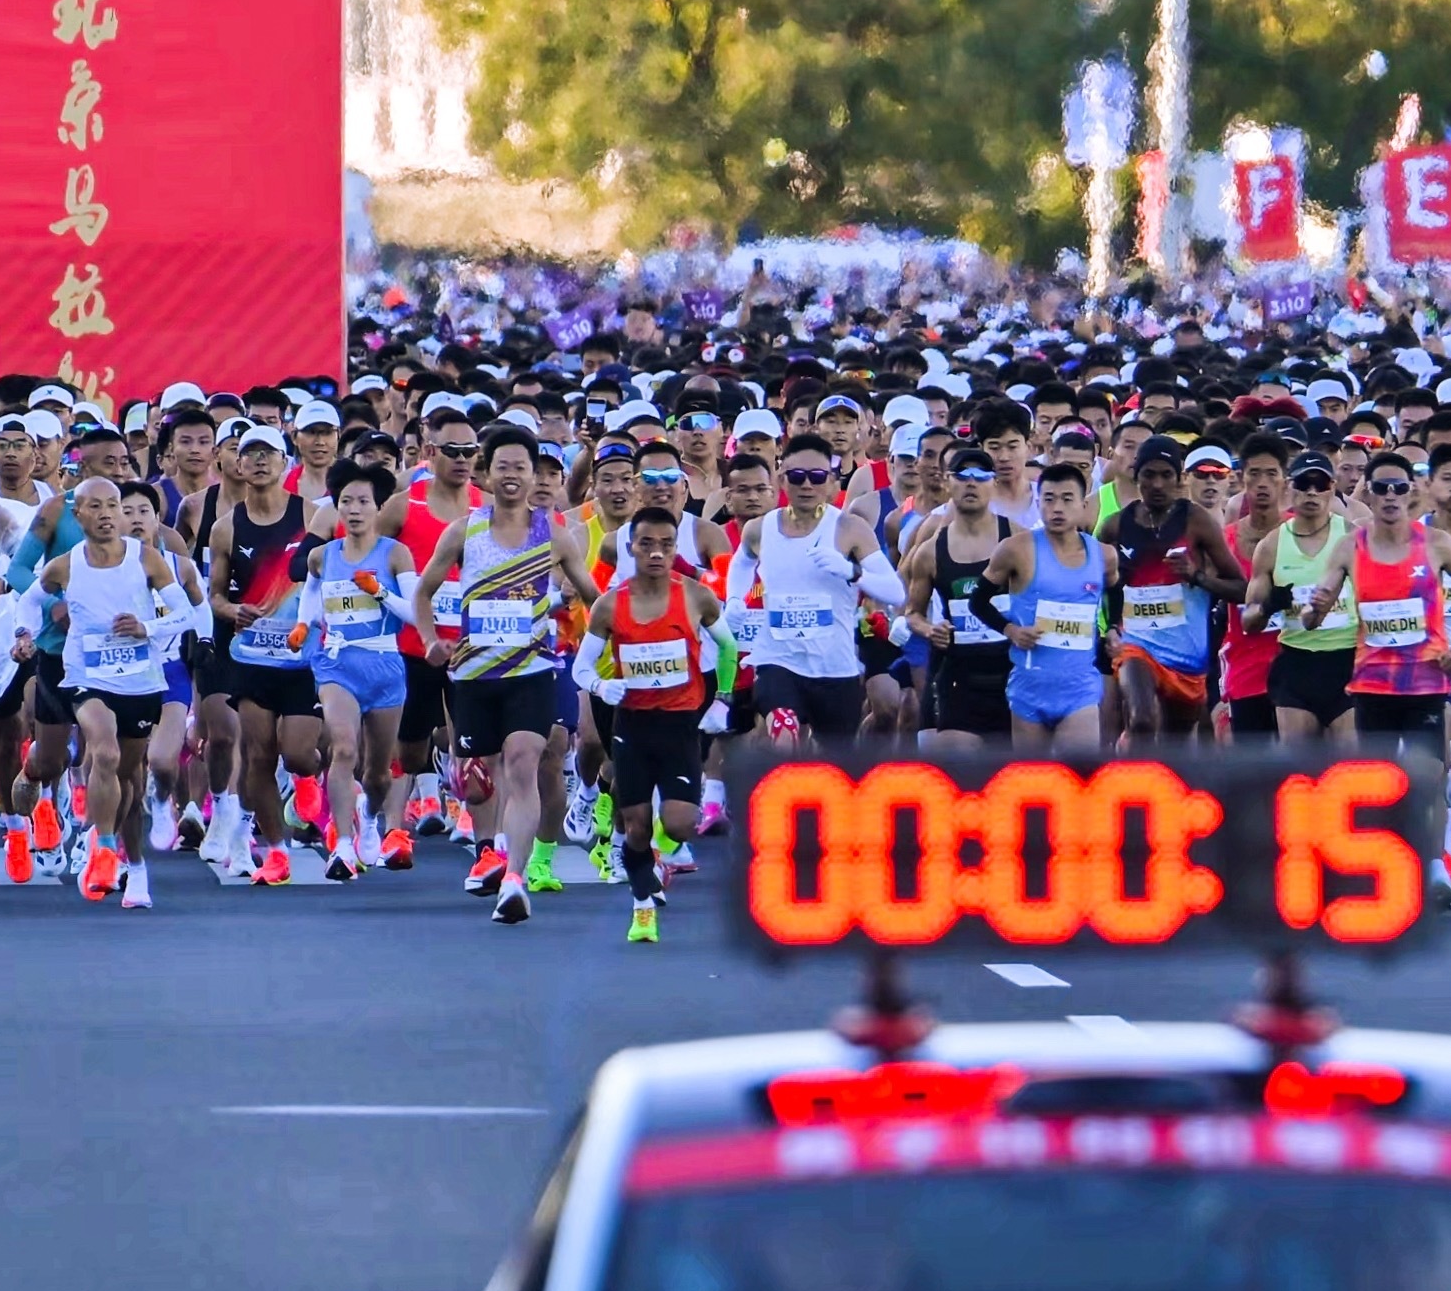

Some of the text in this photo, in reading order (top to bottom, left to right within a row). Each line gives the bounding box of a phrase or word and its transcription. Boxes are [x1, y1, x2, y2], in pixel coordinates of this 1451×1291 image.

[1247, 164, 1283, 229] F
[1402, 156, 1449, 228] E
[342, 596, 354, 609] RI
[1133, 602, 1172, 616] DEBEL
[481, 617, 518, 631] A1710
[781, 610, 818, 625] A3699
[1055, 620, 1080, 634] HAN
[1365, 618, 1418, 633] YANG DH
[99, 649, 136, 663] A1959
[628, 658, 680, 676] YANG CL
